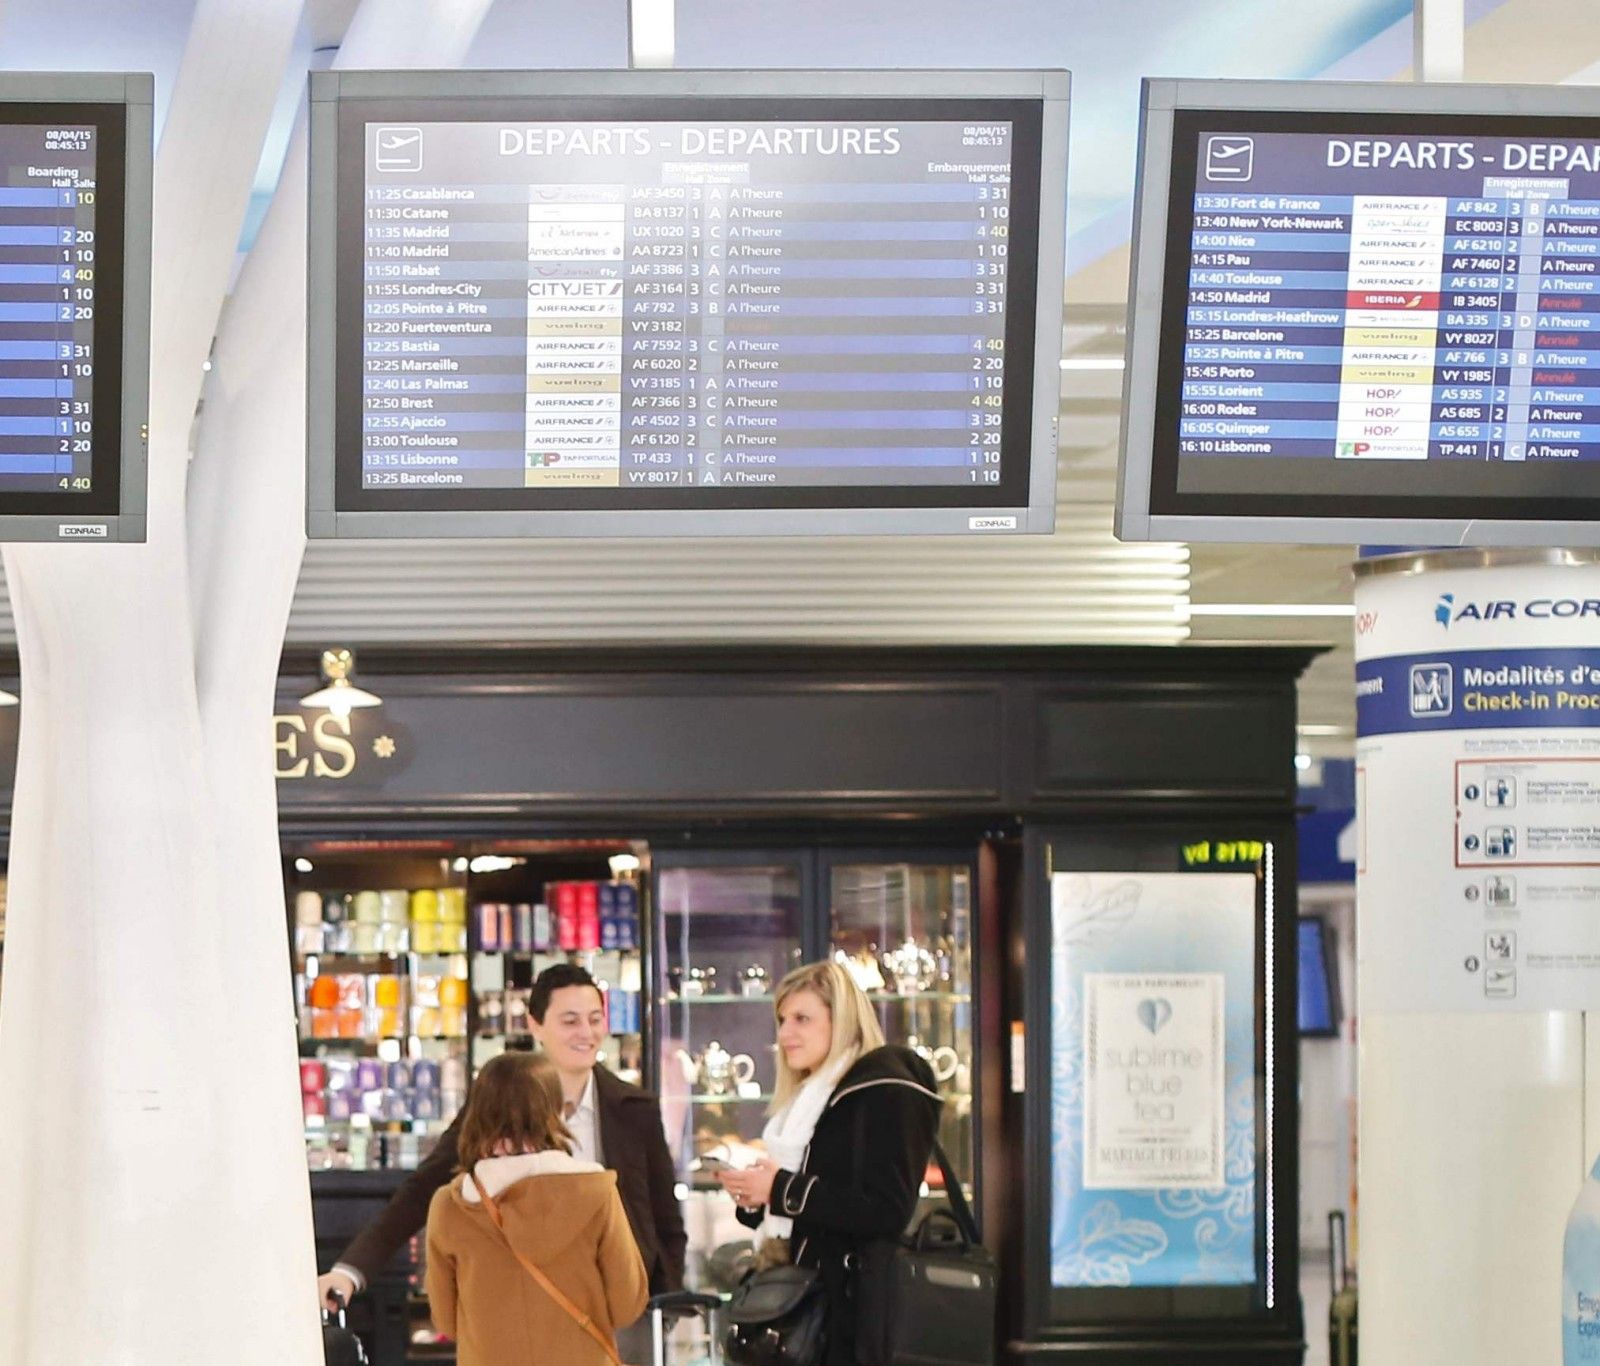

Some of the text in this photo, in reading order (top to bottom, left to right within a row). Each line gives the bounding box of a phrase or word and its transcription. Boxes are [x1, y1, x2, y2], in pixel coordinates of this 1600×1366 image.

[46, 131, 91, 140] 08/04/15
[964, 127, 1007, 136] 08/04/15
[45, 141, 87, 150] 08:45:13
[500, 129, 651, 155] DEPARTS
[681, 127, 901, 155] DEPARTURES
[962, 136, 1003, 145] 08:45:13
[1327, 140, 1475, 170] DEPARTS
[28, 167, 79, 178] Boarding
[928, 163, 1011, 175] Embarquement
[1486, 178, 1567, 189] Enregistrement
[368, 188, 474, 200] 11:25 Casablanca
[1197, 198, 1497, 212] 13:30 Fort de France AF 842
[1196, 217, 1226, 228] 13:40
[1230, 217, 1258, 228] New
[1261, 218, 1343, 229] York-Newark
[1456, 220, 1471, 231] EC
[1473, 221, 1503, 232] 8003
[1510, 223, 1518, 234] 3
[1528, 223, 1539, 234] D
[1546, 223, 1556, 234] A
[63, 250, 70, 261] 1
[76, 250, 94, 261] 10
[367, 283, 683, 296] 11:55 Londres-City CITYJET AF 3164
[1191, 291, 1224, 303] 14:50
[1225, 291, 1270, 303] Madrid
[1365, 295, 1405, 304] IBERIA
[1454, 296, 1466, 306] IB
[1468, 296, 1497, 307] 3405
[1190, 310, 1488, 325] 15:15 Londres-Heathrow BA 335
[367, 321, 682, 333] 12:20 Fuerteventura VY 3182
[366, 398, 399, 408] 12:50
[400, 398, 433, 409] Brest
[632, 397, 648, 407] AF
[650, 397, 680, 408] 7366
[688, 397, 696, 408] 3
[707, 397, 716, 408] C
[725, 397, 734, 407] A
[737, 396, 777, 408] l'heure
[972, 396, 981, 407] 4
[985, 396, 1002, 407] 40
[1183, 423, 1214, 434] 16:05
[1215, 423, 1270, 436] Quimper
[1181, 441, 1271, 453] 16:10 Lisbonne
[1455, 602, 1519, 622] AIR
[1464, 666, 1564, 686] Modalités
[1464, 692, 1549, 711] Check-in
[1127, 1073, 1181, 1096] blue
